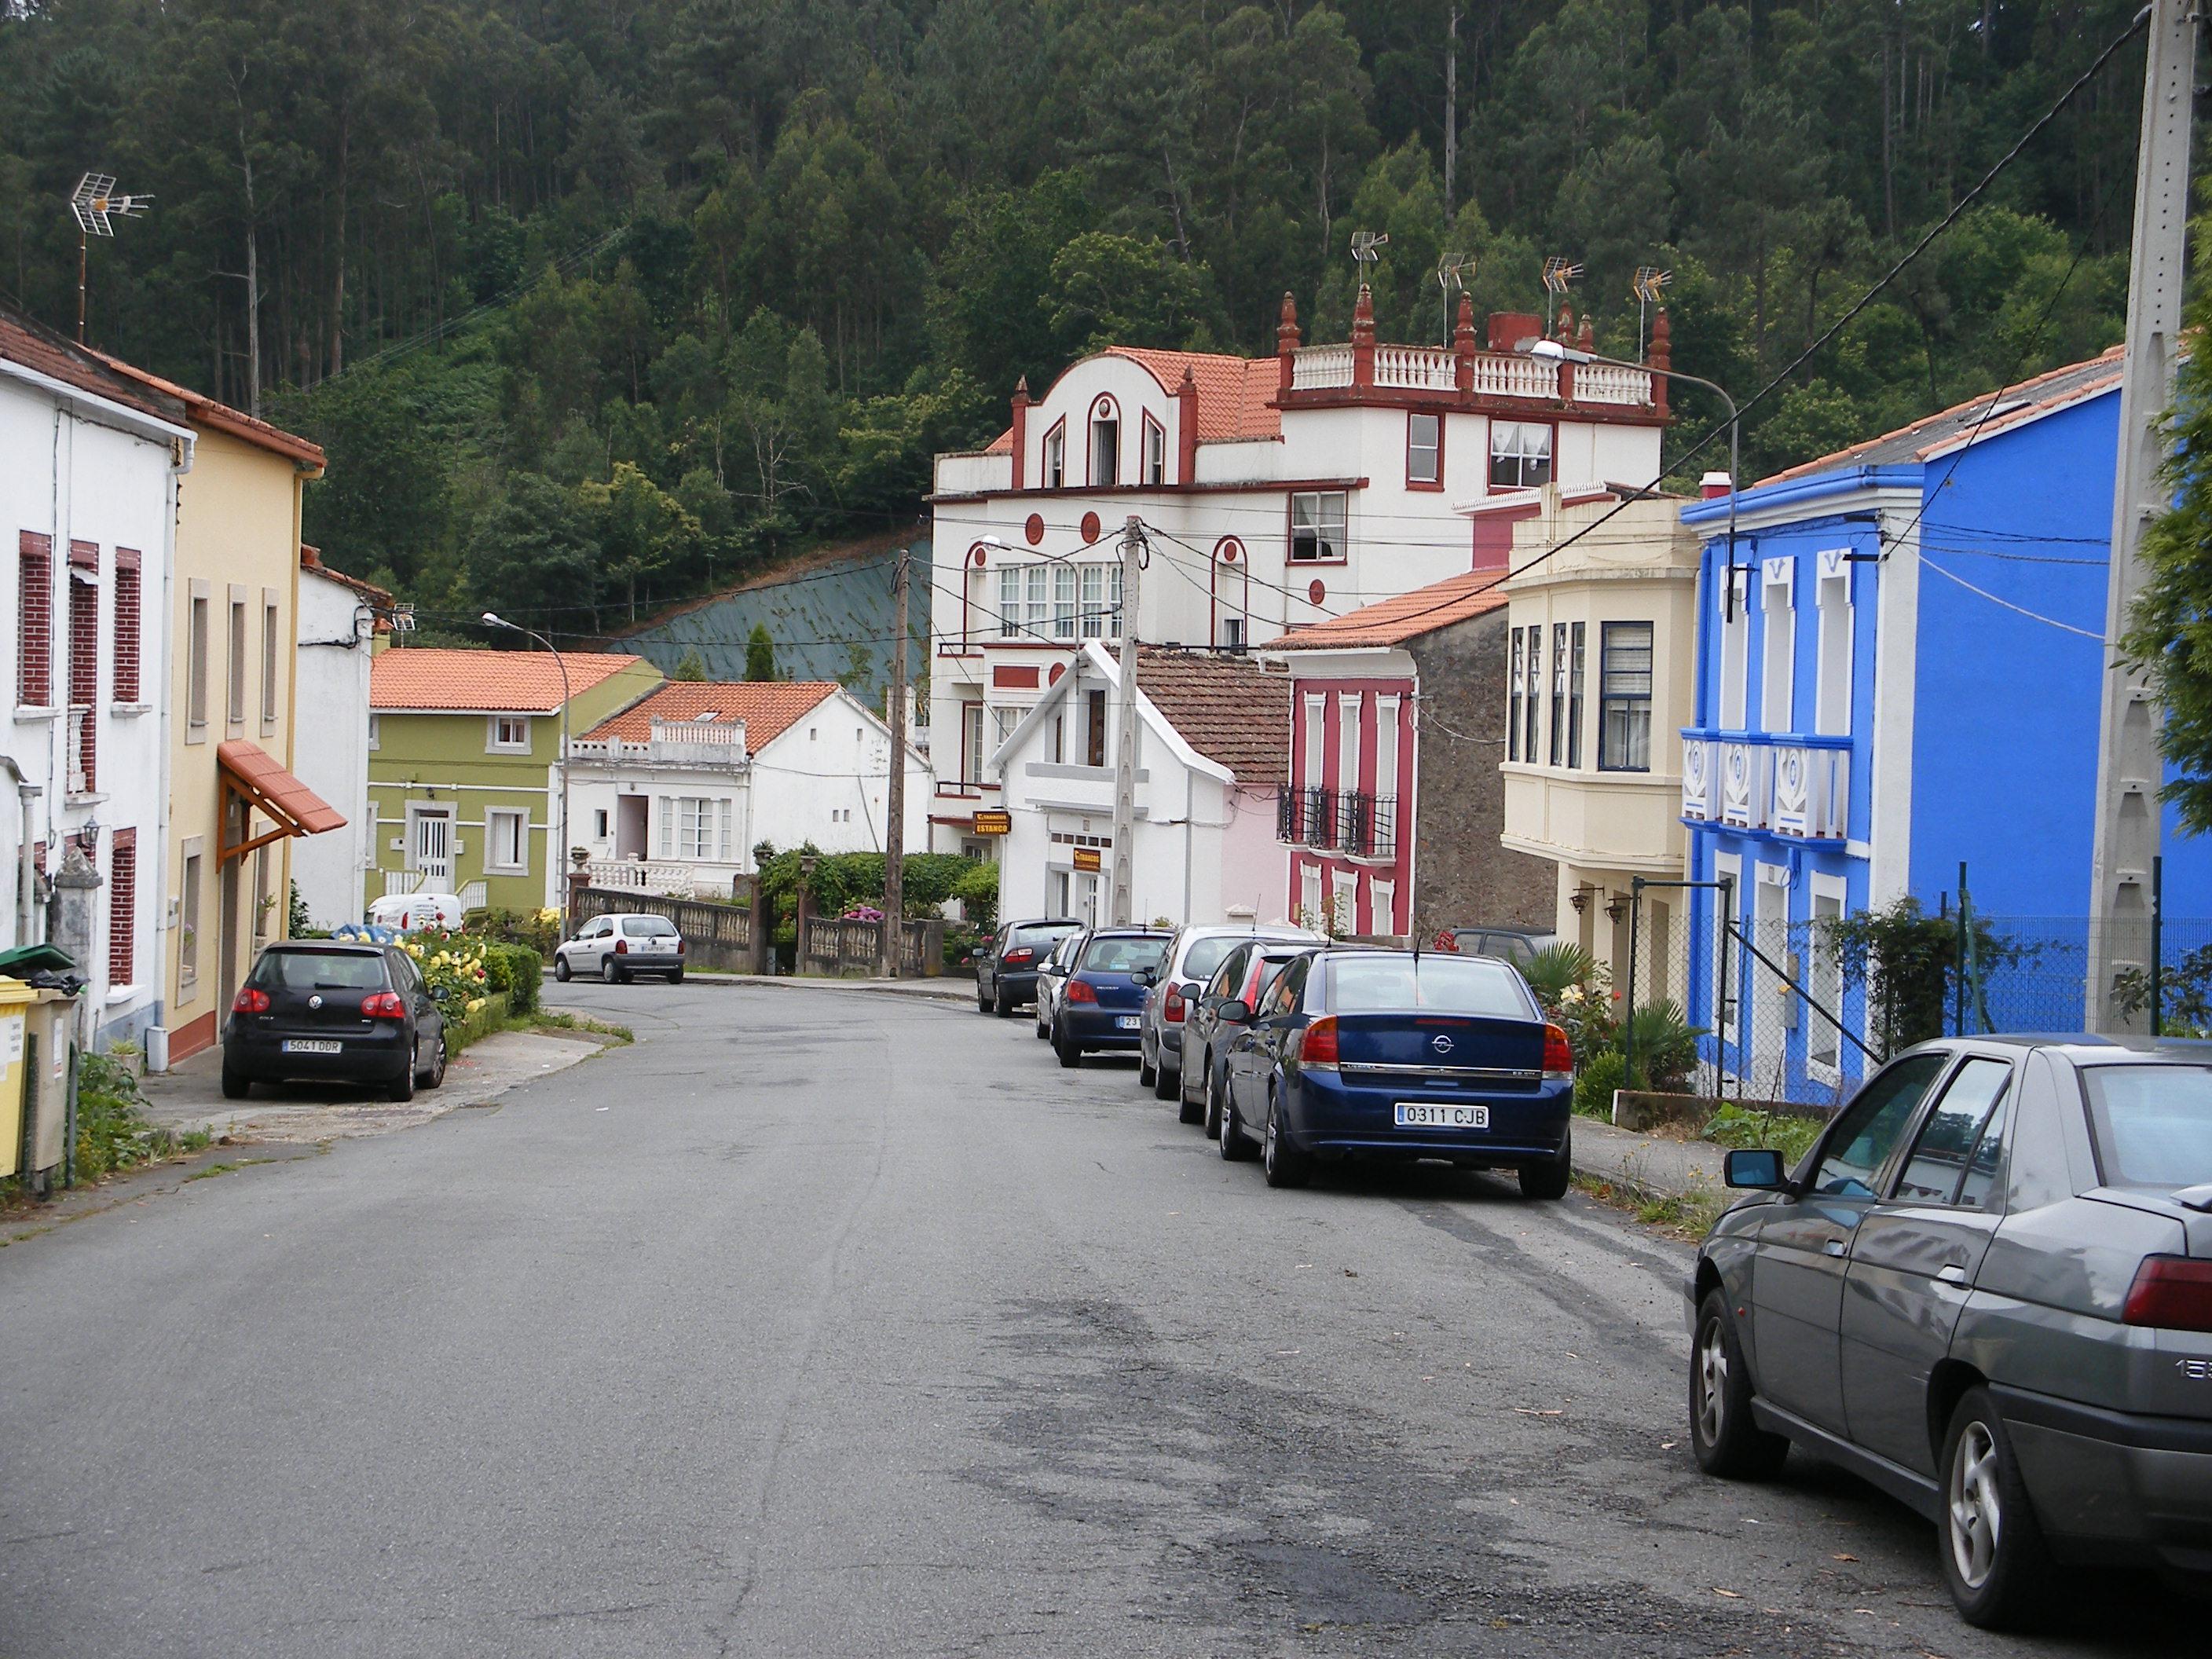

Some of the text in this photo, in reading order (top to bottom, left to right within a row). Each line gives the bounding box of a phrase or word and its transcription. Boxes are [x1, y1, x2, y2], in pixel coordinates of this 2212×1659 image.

[290, 1040, 339, 1051] 5041 DDR
[1407, 1108, 1485, 1124] 0311 CJB
[2174, 1359, 2212, 1379] 15
